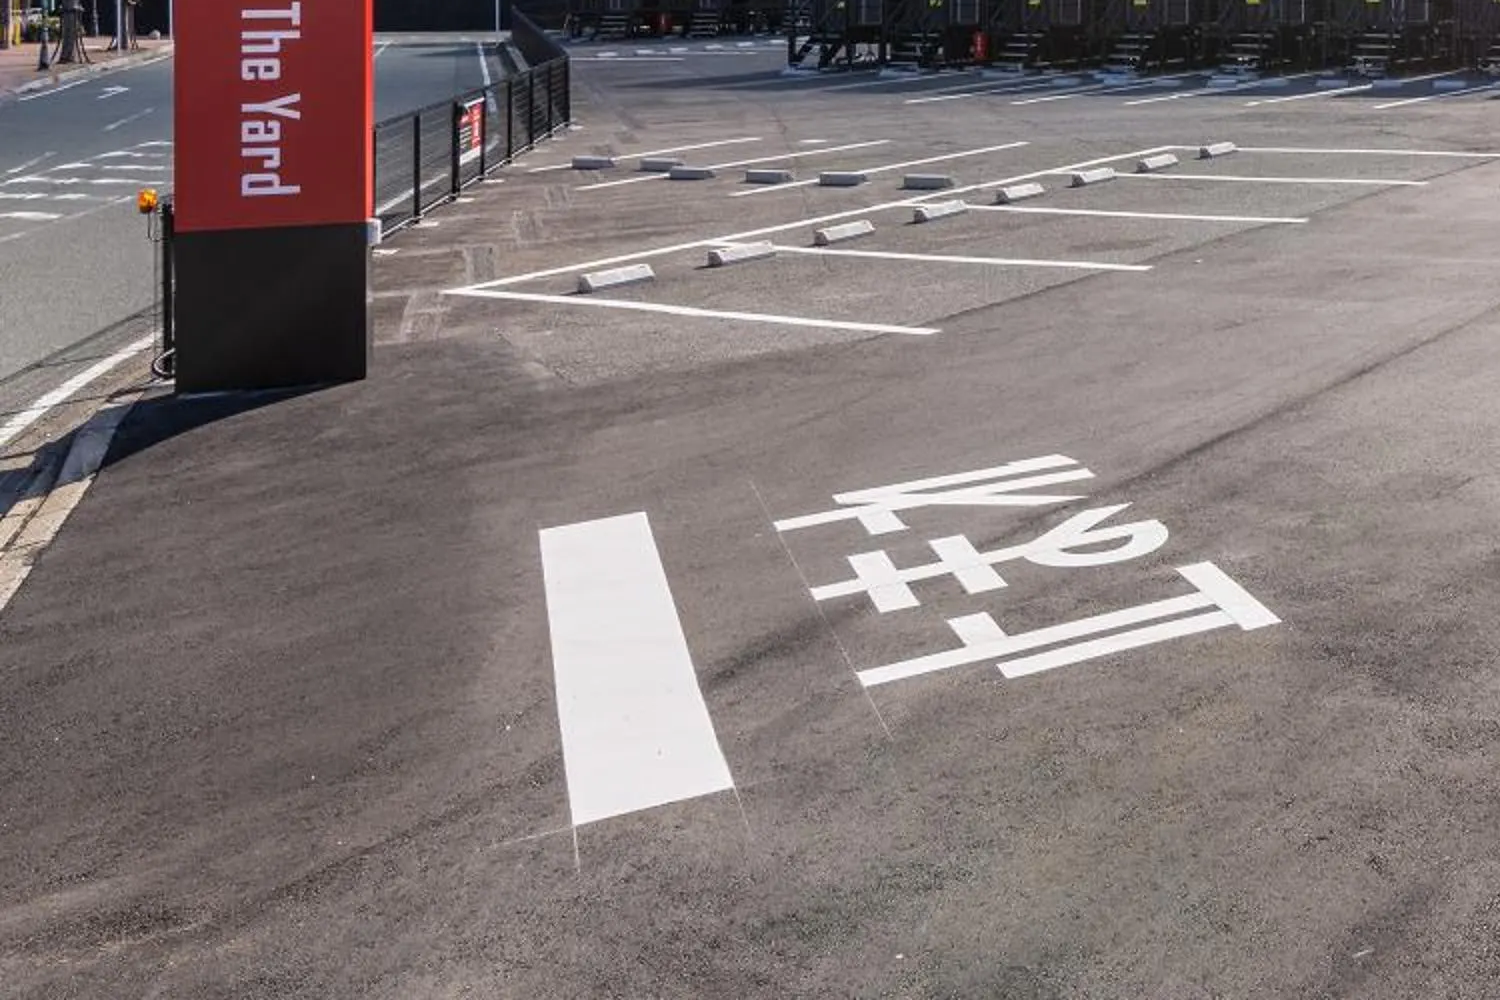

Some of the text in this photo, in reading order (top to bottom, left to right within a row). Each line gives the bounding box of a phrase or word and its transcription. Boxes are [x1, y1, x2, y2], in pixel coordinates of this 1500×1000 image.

[241, 1, 301, 81] The
[241, 92, 301, 197] Yard
[773, 453, 1282, 687] 止まれ
